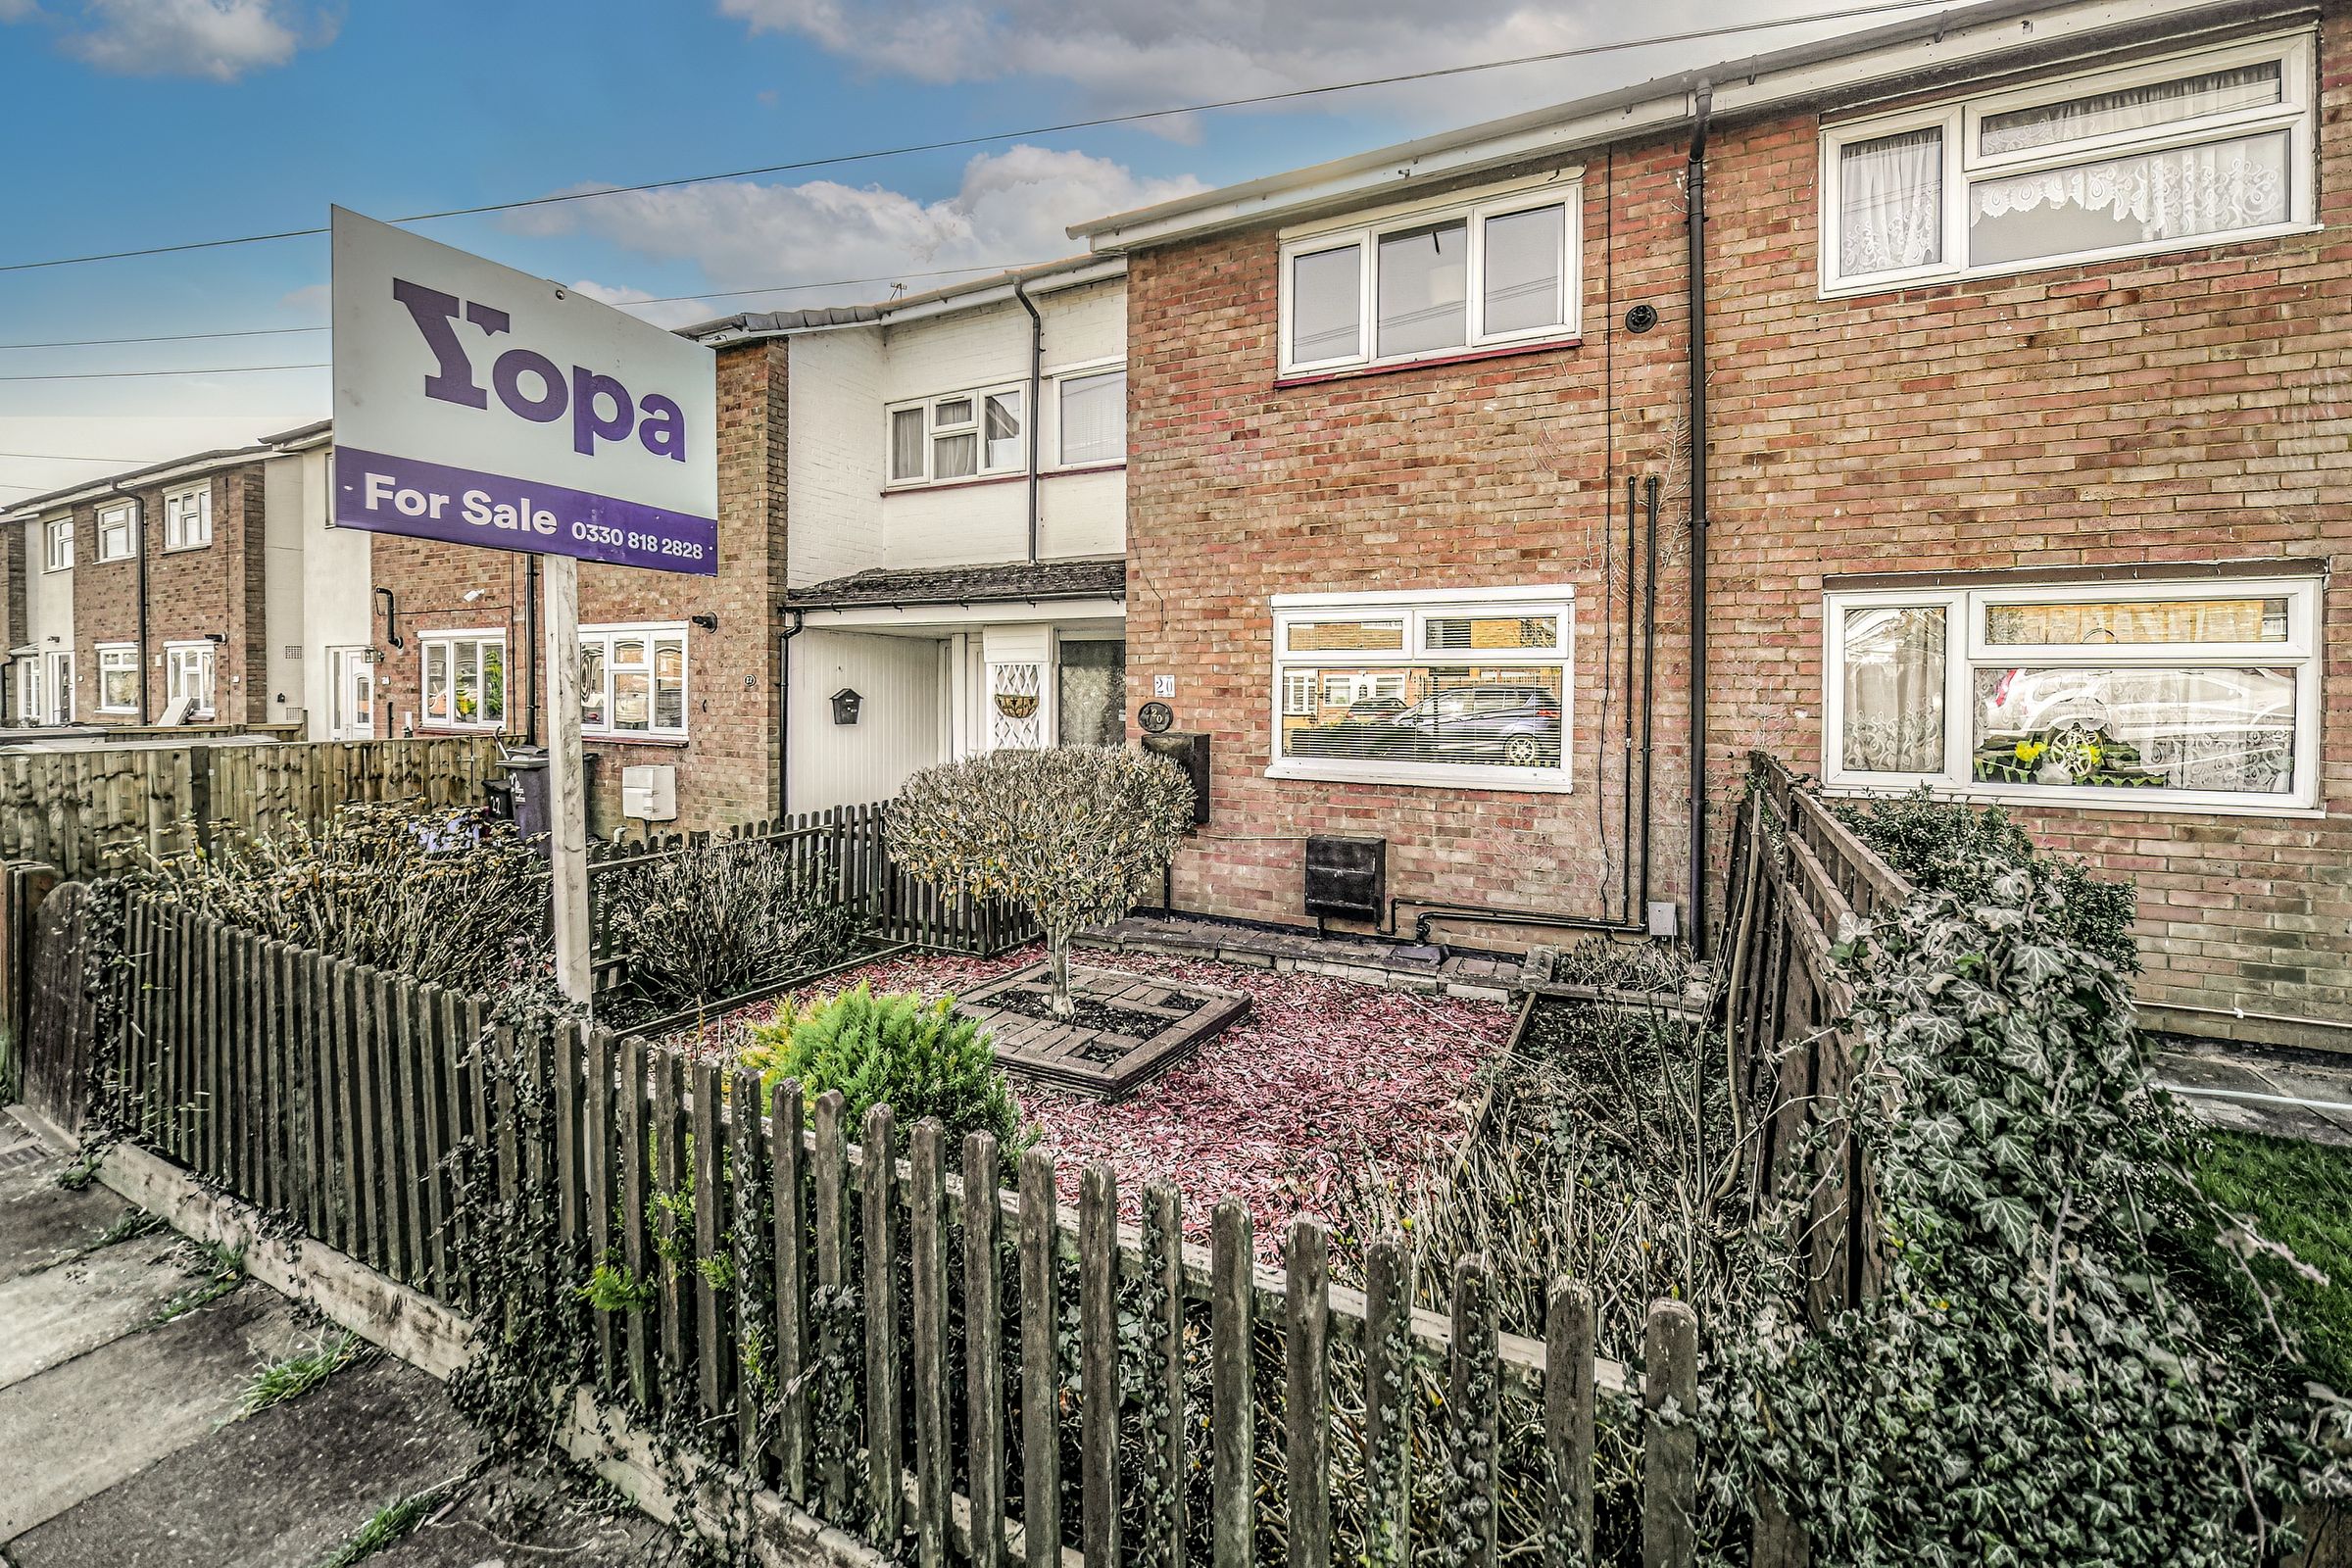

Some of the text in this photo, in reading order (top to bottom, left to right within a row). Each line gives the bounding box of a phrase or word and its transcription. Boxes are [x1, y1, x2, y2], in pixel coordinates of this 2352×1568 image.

[393, 277, 686, 463] Yopa
[365, 472, 558, 535] For Sale
[571, 521, 704, 560] 0330 818 2828
[1155, 677, 1173, 696] 20
[1152, 708, 1162, 723] 20
